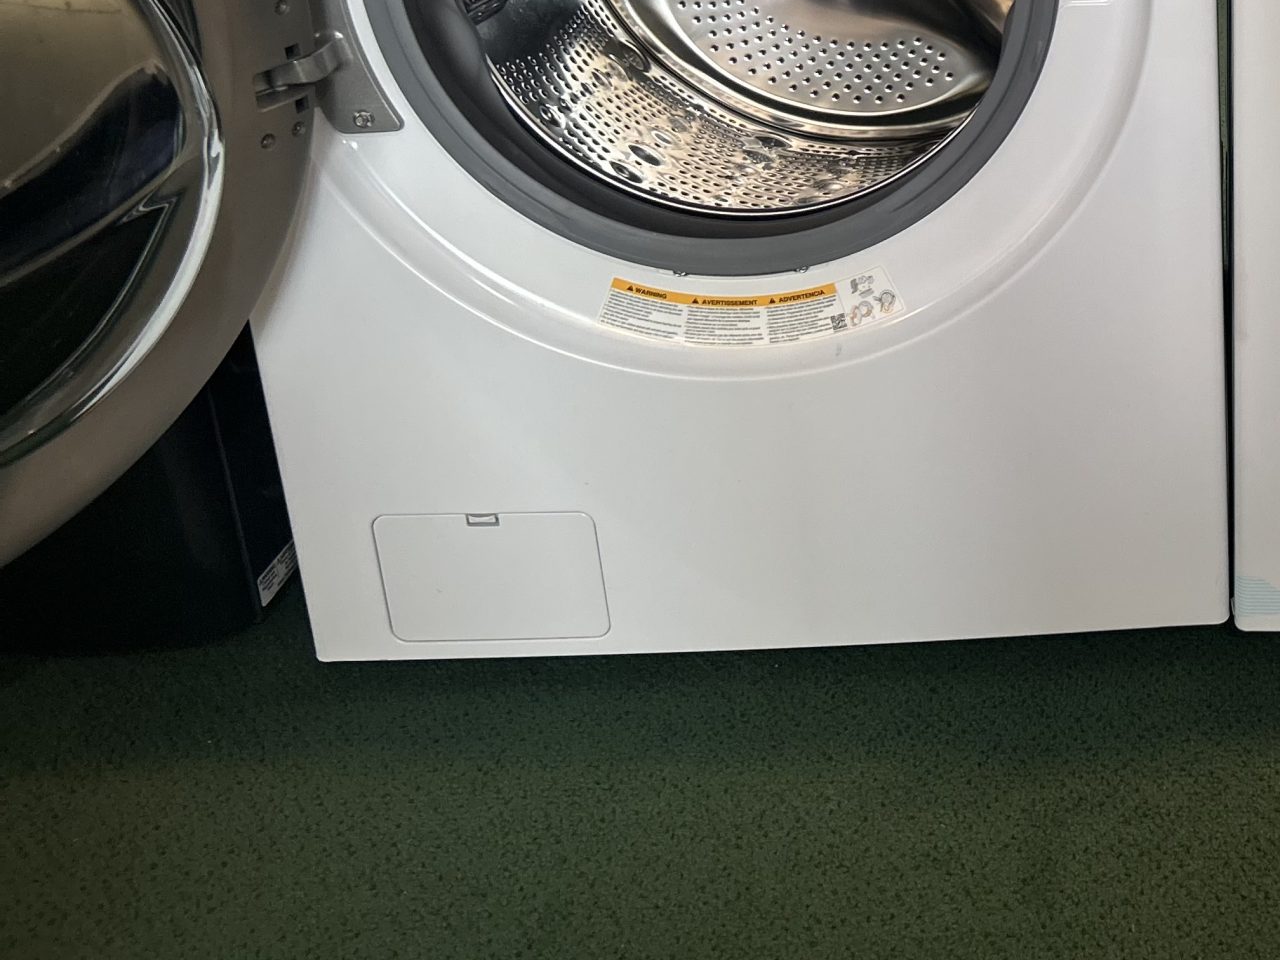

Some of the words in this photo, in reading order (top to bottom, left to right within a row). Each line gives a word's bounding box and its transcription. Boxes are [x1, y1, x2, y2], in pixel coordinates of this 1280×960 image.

[635, 287, 668, 300] WARNING
[778, 290, 826, 303] ADVERTENCIA
[701, 299, 758, 307] AVERTISSEMENT
